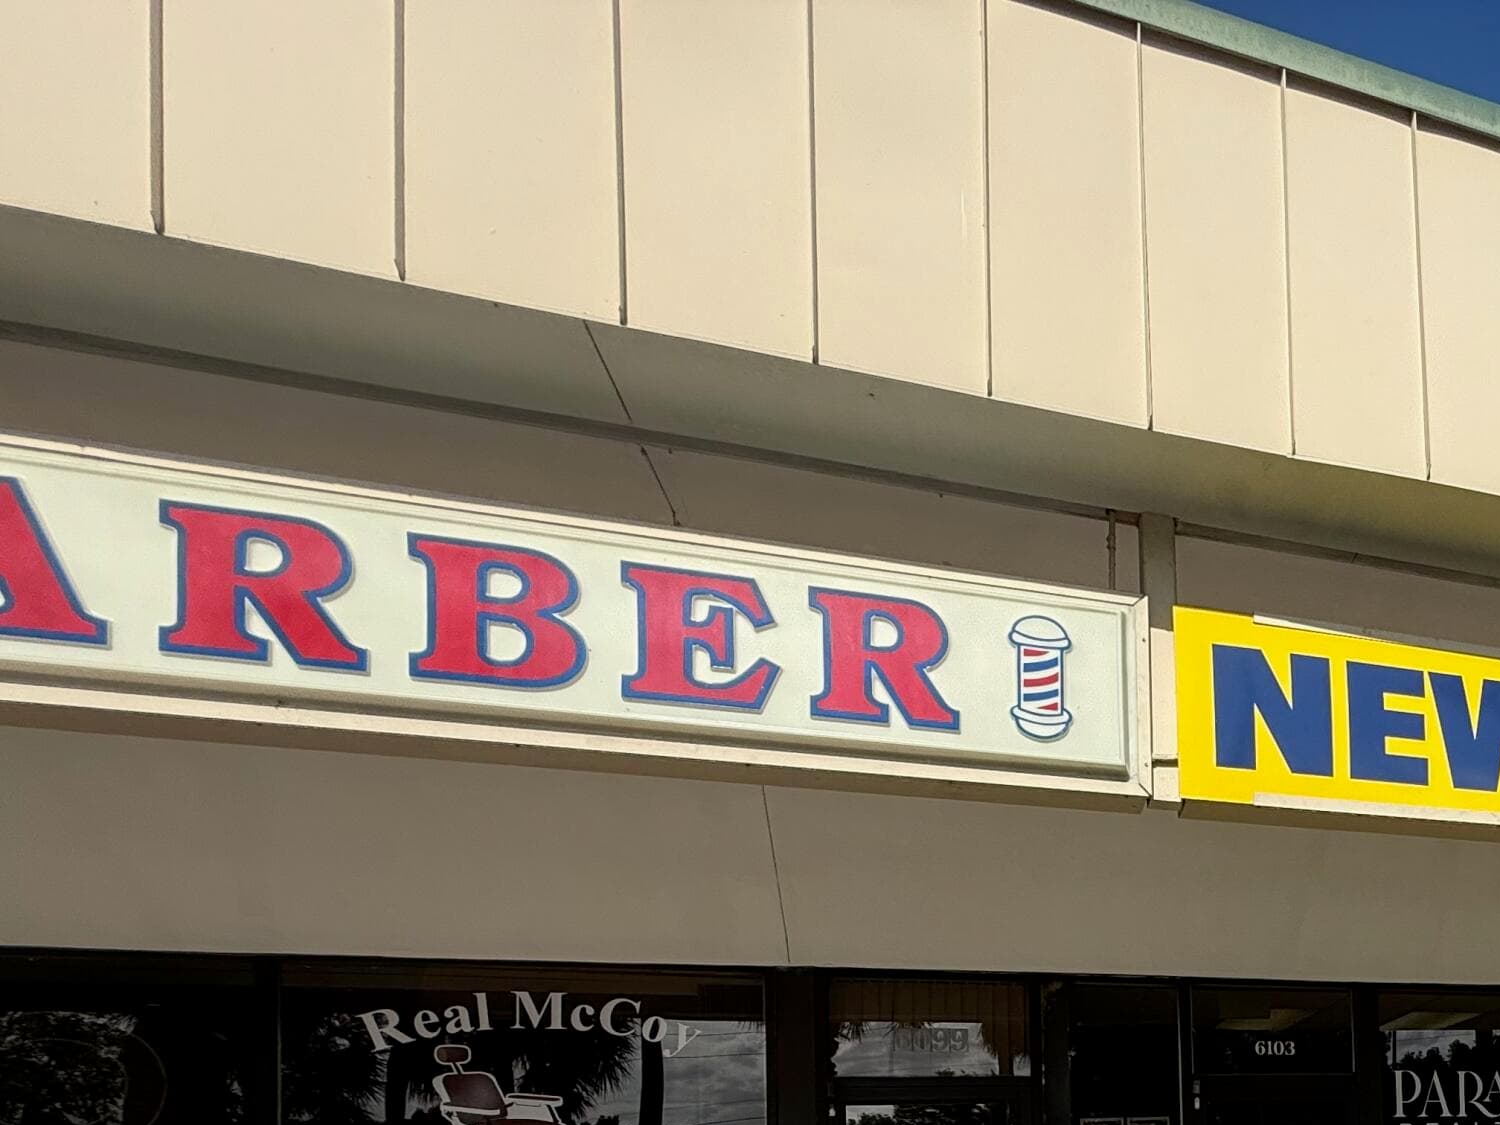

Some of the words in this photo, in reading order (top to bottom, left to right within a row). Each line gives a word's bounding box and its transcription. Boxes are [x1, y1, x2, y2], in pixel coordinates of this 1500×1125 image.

[354, 992, 494, 1053] Real
[510, 991, 702, 1057] McCoy
[1255, 1041, 1296, 1055] 6103
